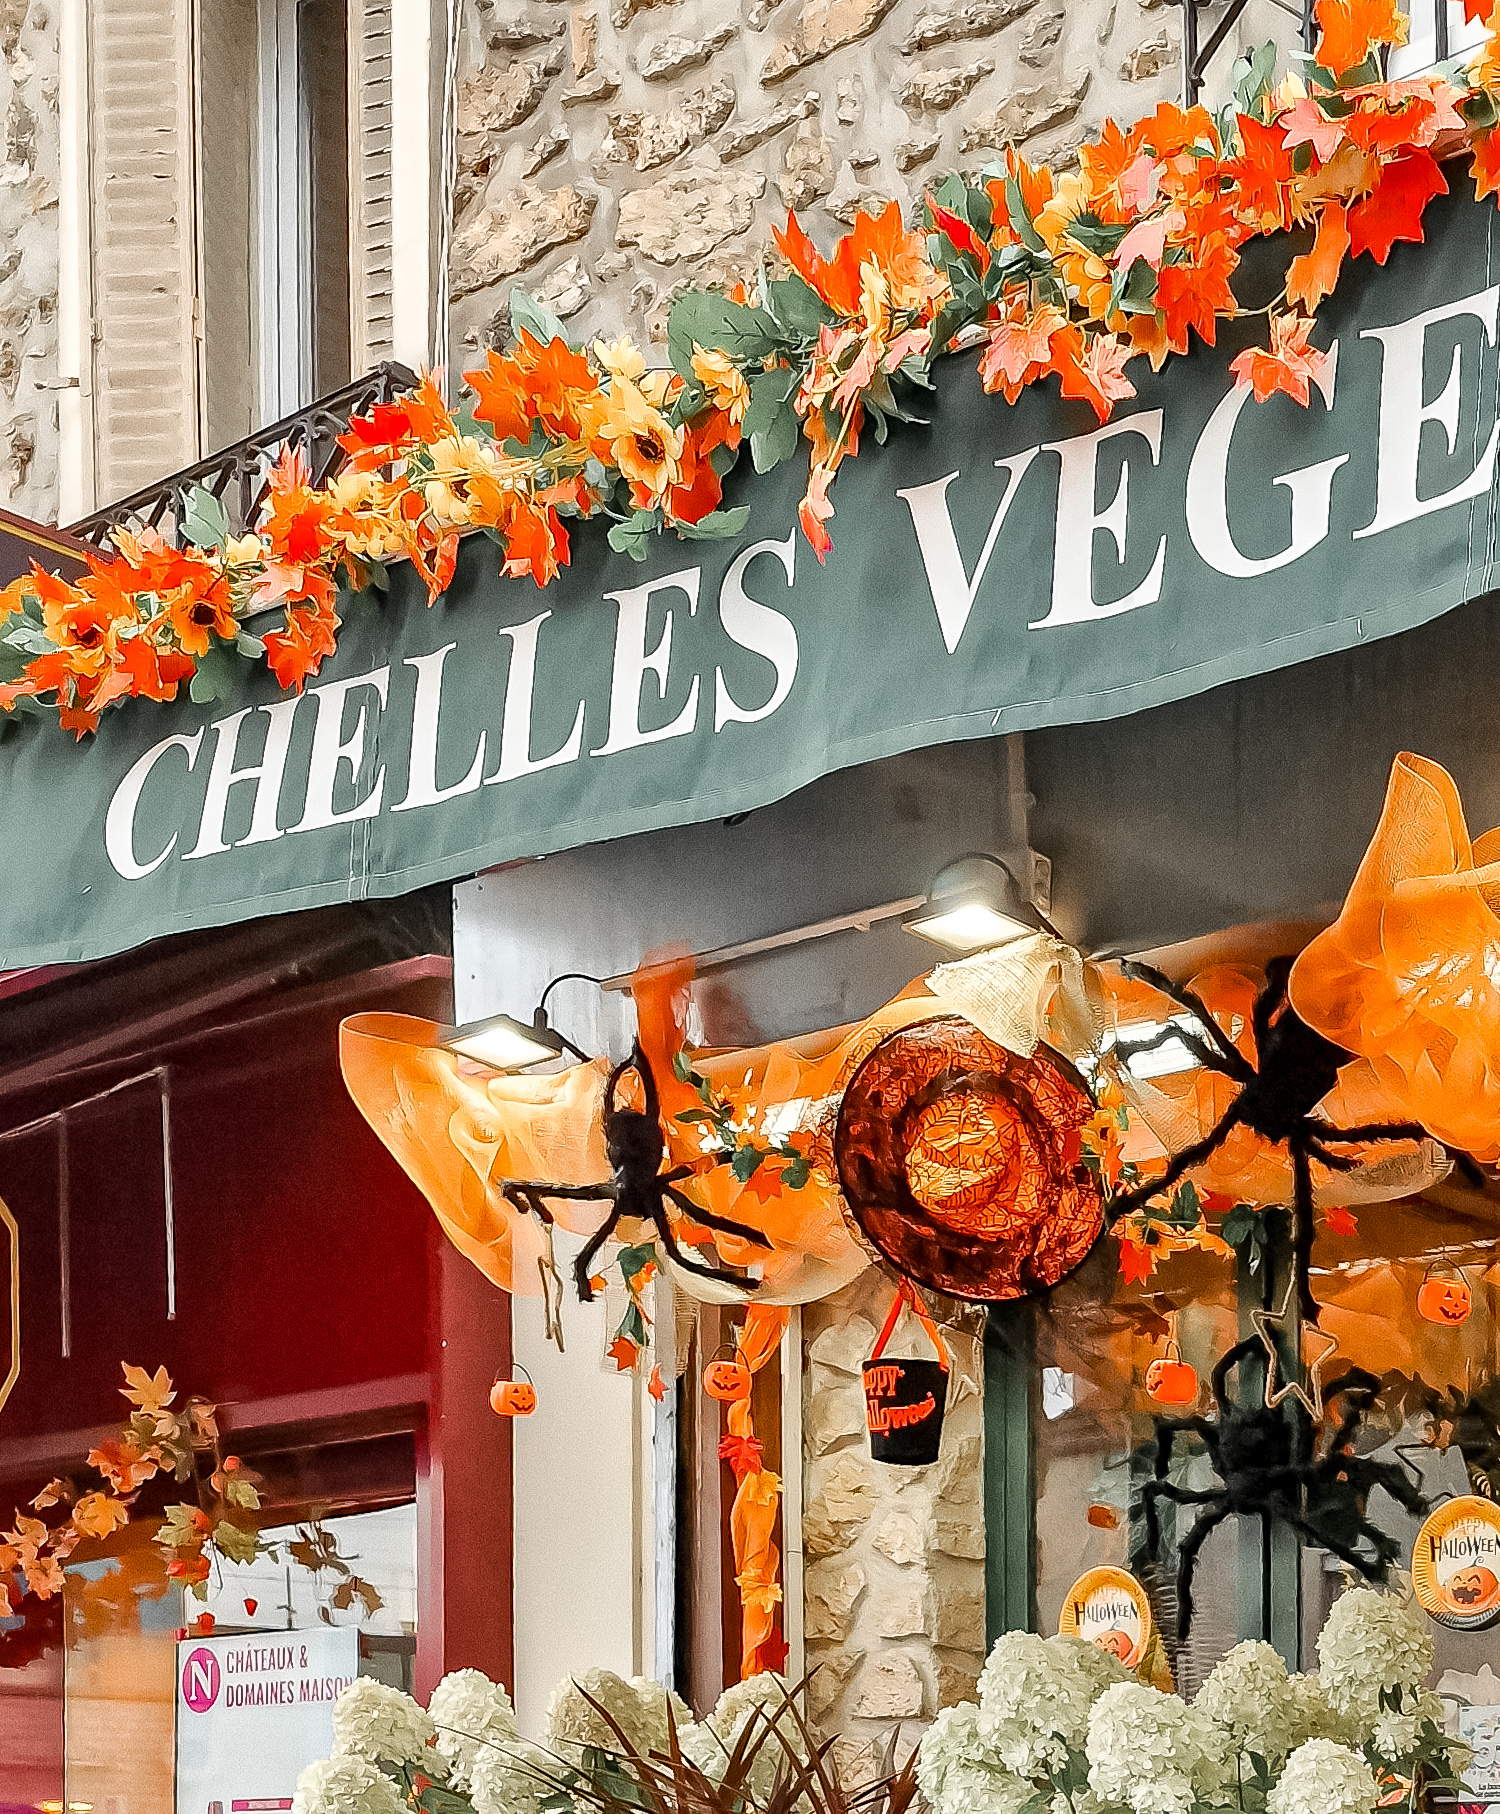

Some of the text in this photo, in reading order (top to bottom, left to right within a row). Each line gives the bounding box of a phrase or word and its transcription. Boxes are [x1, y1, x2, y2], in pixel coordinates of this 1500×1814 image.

[103, 526, 799, 881] CHELLES
[226, 1643, 309, 1673] CHÂTEAUX &
[190, 1660, 213, 1701] N
[226, 1680, 294, 1707] DOMAINES
